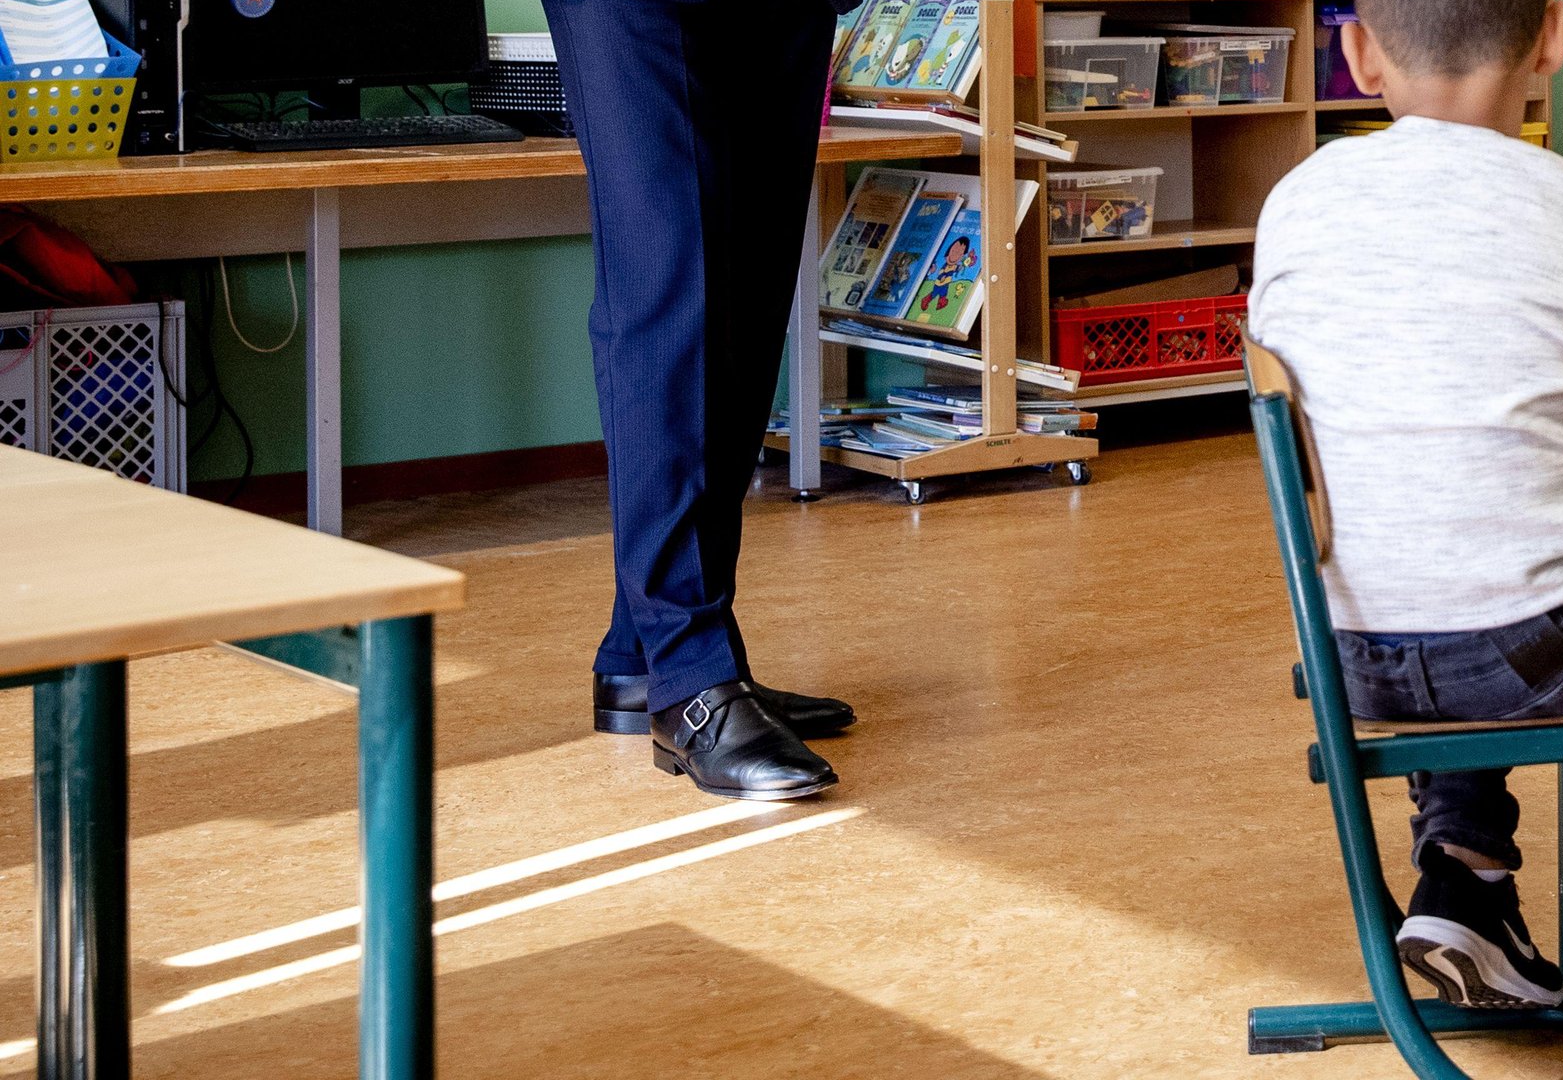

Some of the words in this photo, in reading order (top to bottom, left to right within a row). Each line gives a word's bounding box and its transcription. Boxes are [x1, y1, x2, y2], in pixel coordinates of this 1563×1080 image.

[880, 5, 903, 15] BORRE
[917, 7, 940, 18] BORRE
[954, 5, 978, 15] BORRE
